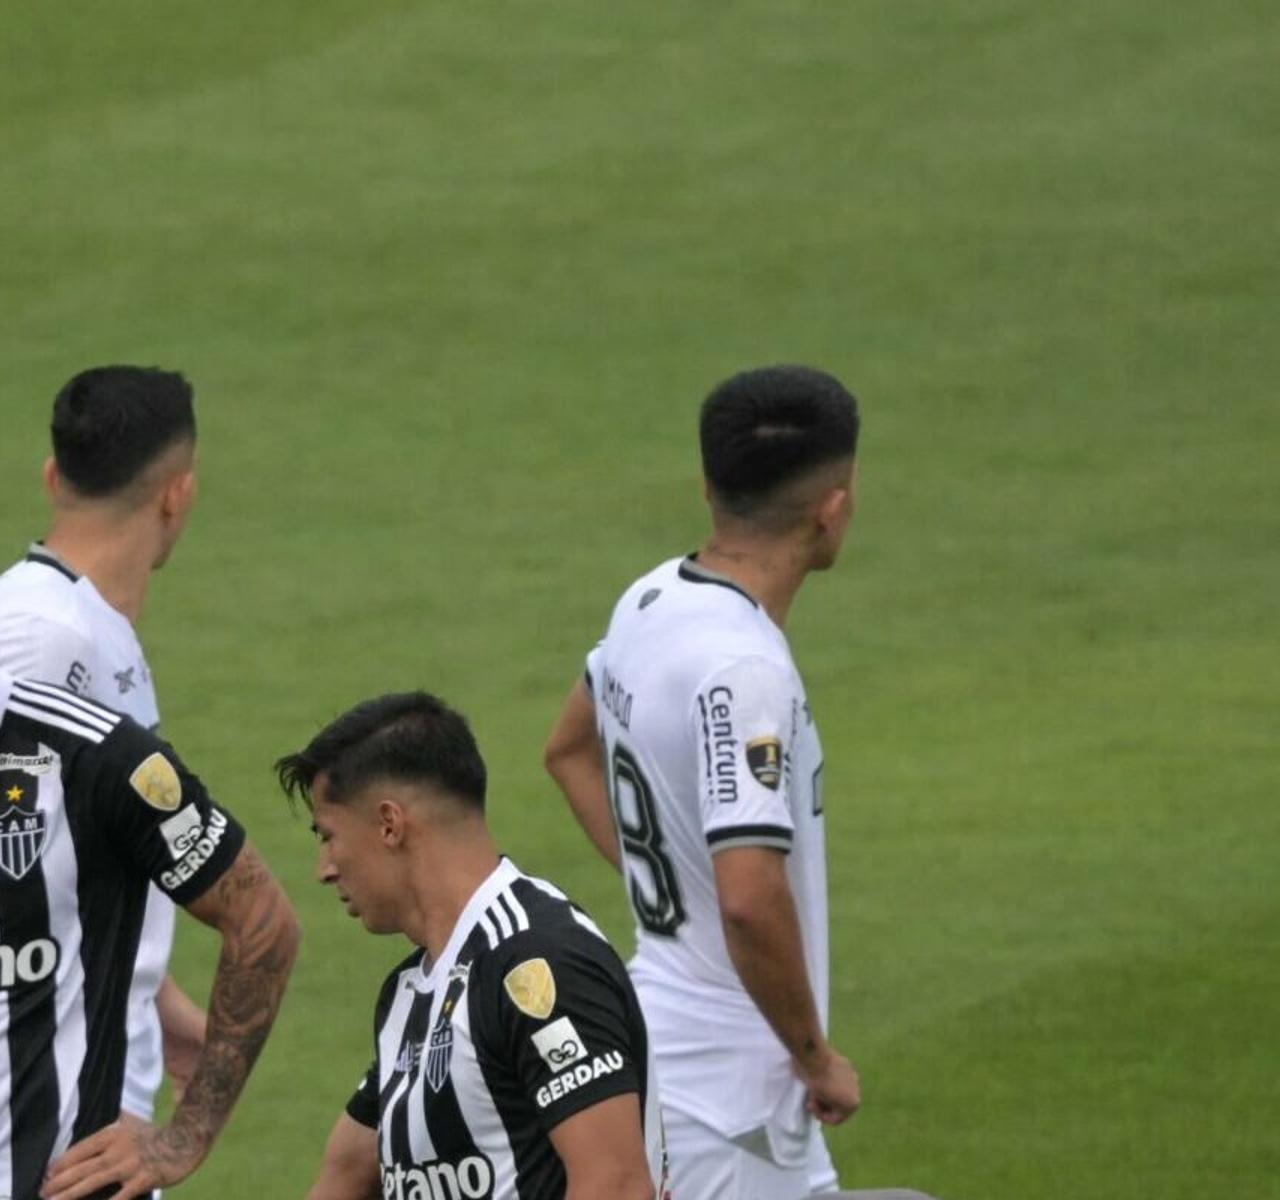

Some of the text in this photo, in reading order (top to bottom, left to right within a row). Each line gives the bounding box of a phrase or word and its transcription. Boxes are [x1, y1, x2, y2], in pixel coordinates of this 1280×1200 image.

[708, 685, 739, 804] Centrum
[158, 807, 228, 891] GERDAU
[536, 1050, 625, 1108] GERDAU
